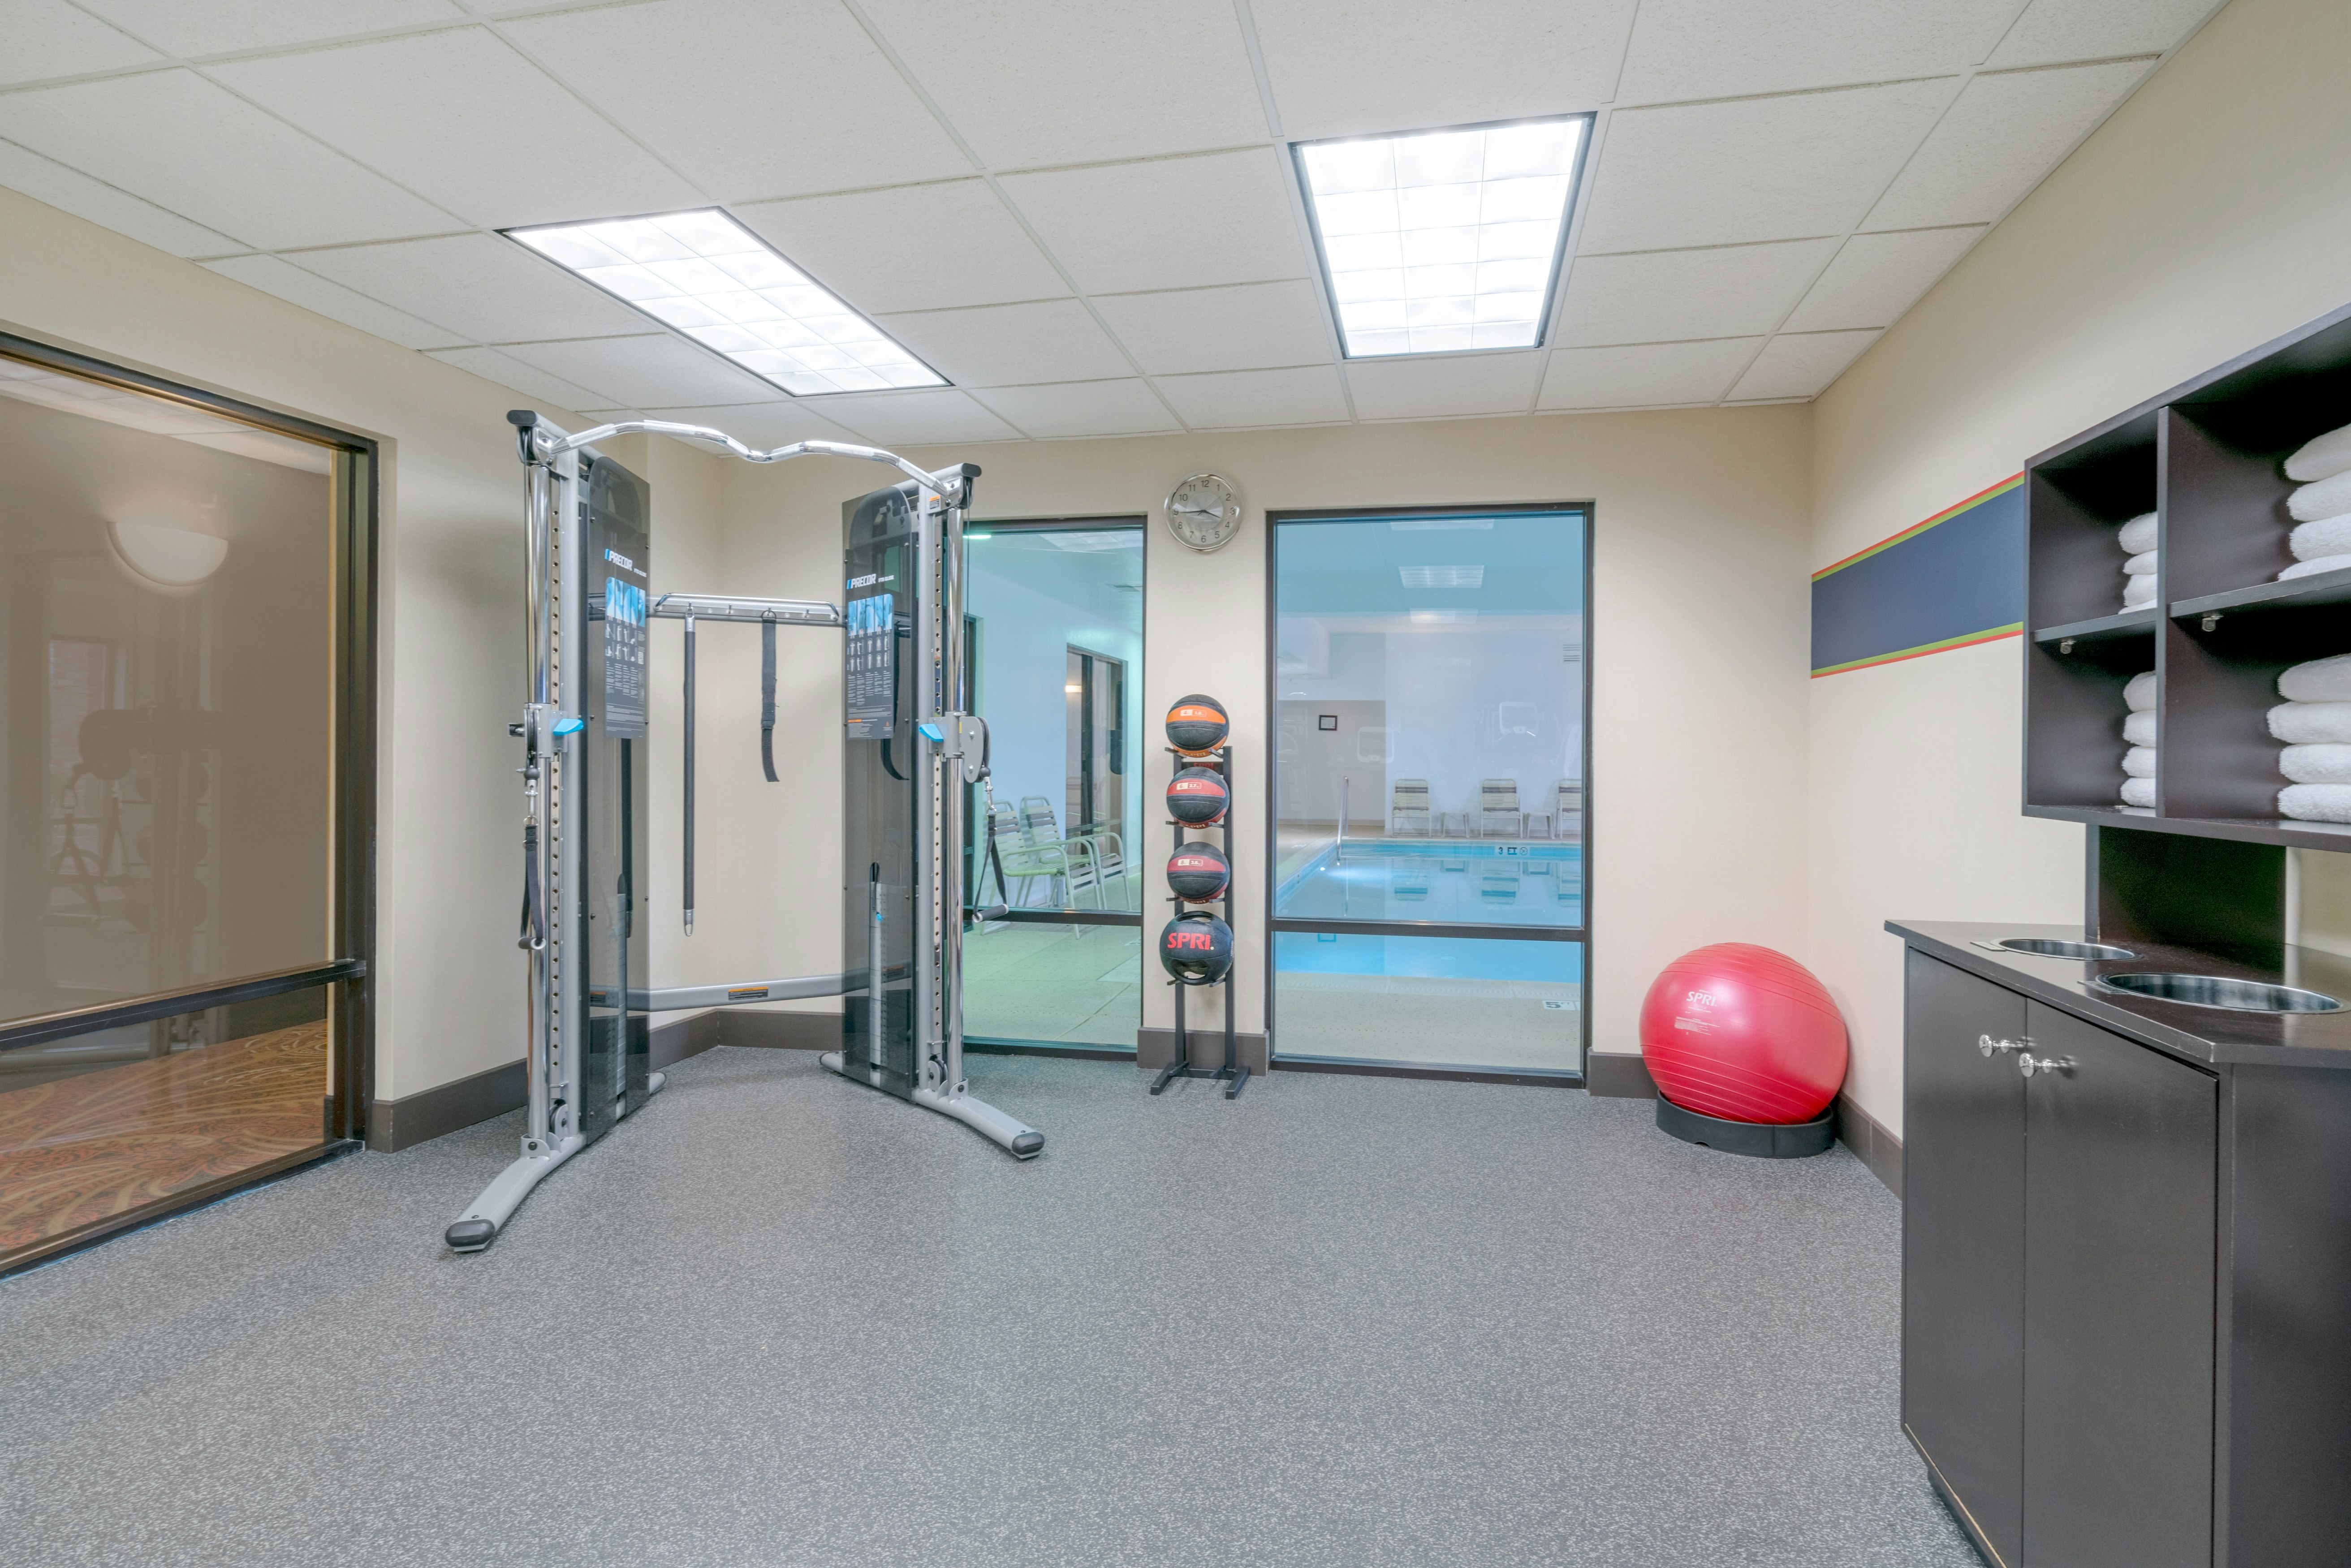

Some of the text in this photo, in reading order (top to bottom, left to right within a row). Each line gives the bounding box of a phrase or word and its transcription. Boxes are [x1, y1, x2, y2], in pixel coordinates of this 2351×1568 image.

[608, 550, 633, 571] PRECOR
[850, 573, 876, 589] PRECOR
[1498, 847, 1503, 855] 3
[1686, 991, 1717, 1006] SPRI
